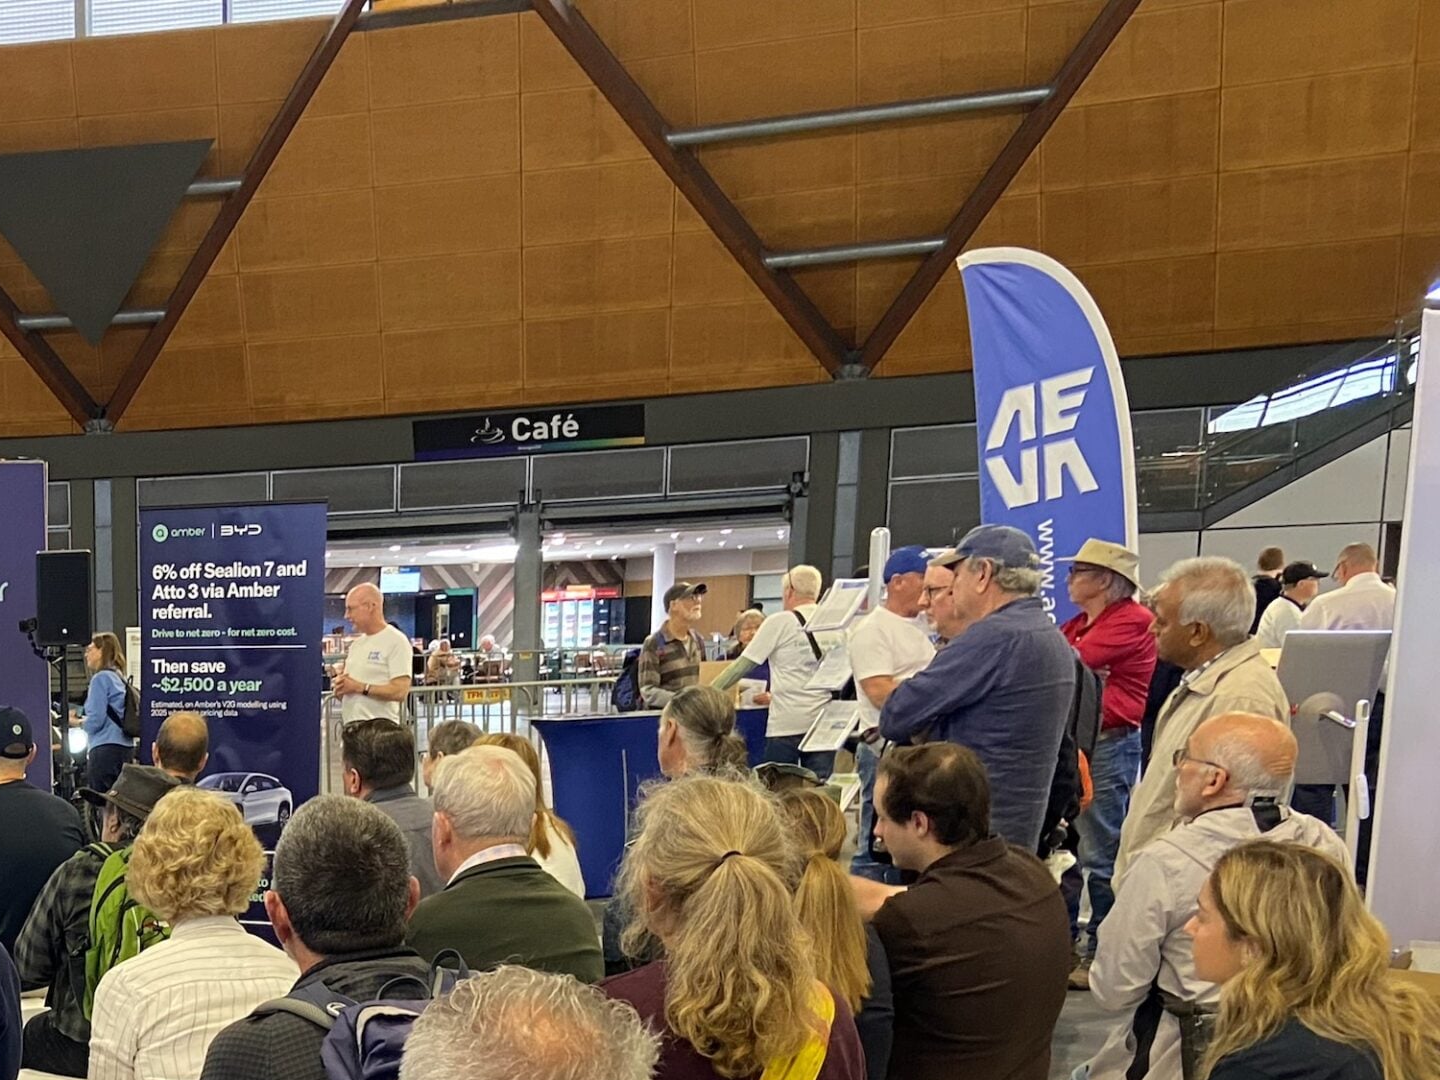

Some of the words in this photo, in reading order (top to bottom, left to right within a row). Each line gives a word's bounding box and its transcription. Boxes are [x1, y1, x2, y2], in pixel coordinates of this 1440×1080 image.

[512, 414, 579, 441] Café
[170, 528, 206, 537] amber
[220, 524, 262, 536] BYD
[152, 563, 178, 580] 6%
[180, 562, 202, 579] off
[203, 561, 261, 579] Sealion
[264, 561, 275, 577] 7
[276, 560, 307, 577] and
[152, 584, 185, 600] Atto
[188, 583, 199, 599] 3
[201, 583, 224, 598] via
[226, 581, 280, 598] Amber
[152, 603, 212, 619] referral.
[151, 629, 174, 638] Drive
[176, 629, 184, 637] to
[186, 629, 201, 637] net
[227, 628, 240, 637] for
[241, 628, 256, 637] net
[256, 629, 275, 637] zero
[276, 627, 298, 637] cost.
[151, 659, 189, 674] Then
[190, 661, 226, 673] save
[151, 677, 214, 694] ~$2,500
[217, 680, 226, 691] a
[229, 680, 262, 695] year
[269, 701, 287, 710] using
